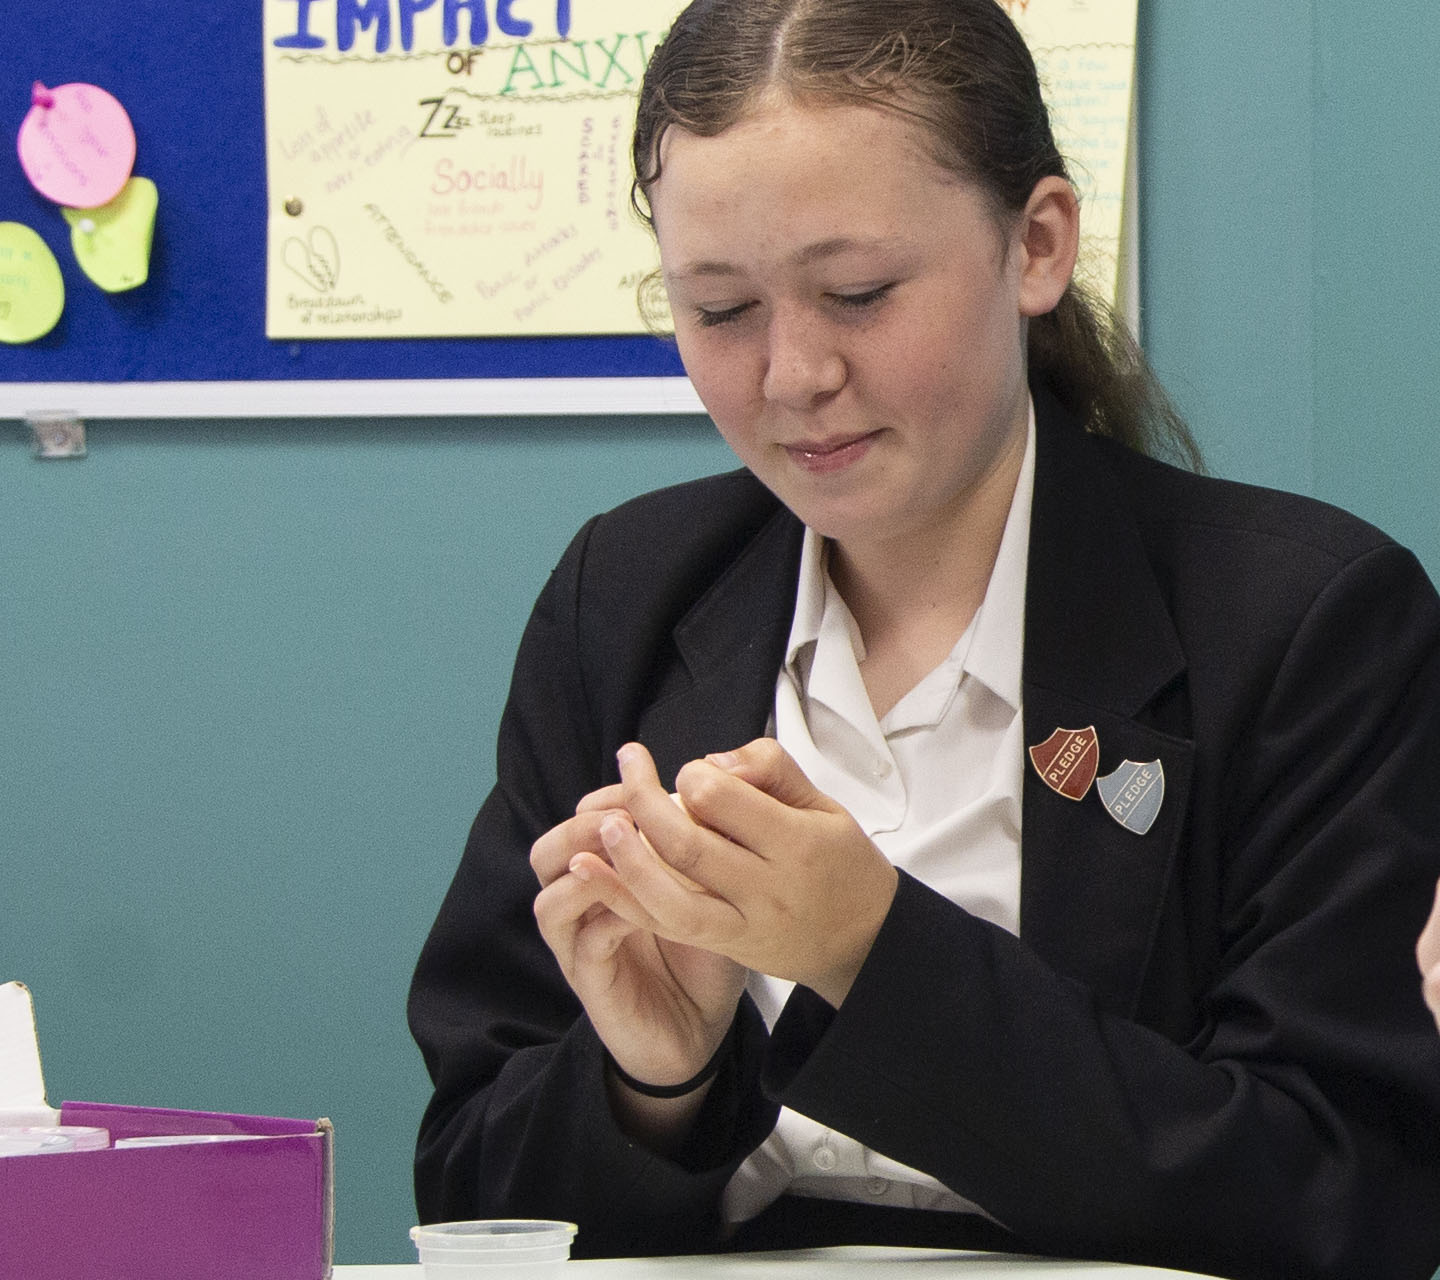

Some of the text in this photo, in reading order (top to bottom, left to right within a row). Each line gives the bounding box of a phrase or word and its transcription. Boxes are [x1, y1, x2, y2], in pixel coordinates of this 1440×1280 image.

[500, 30, 662, 97] ANXI
[429, 153, 546, 213] Socially
[1048, 734, 1089, 784] PLEDGE
[1113, 767, 1154, 817] PLEDGE
